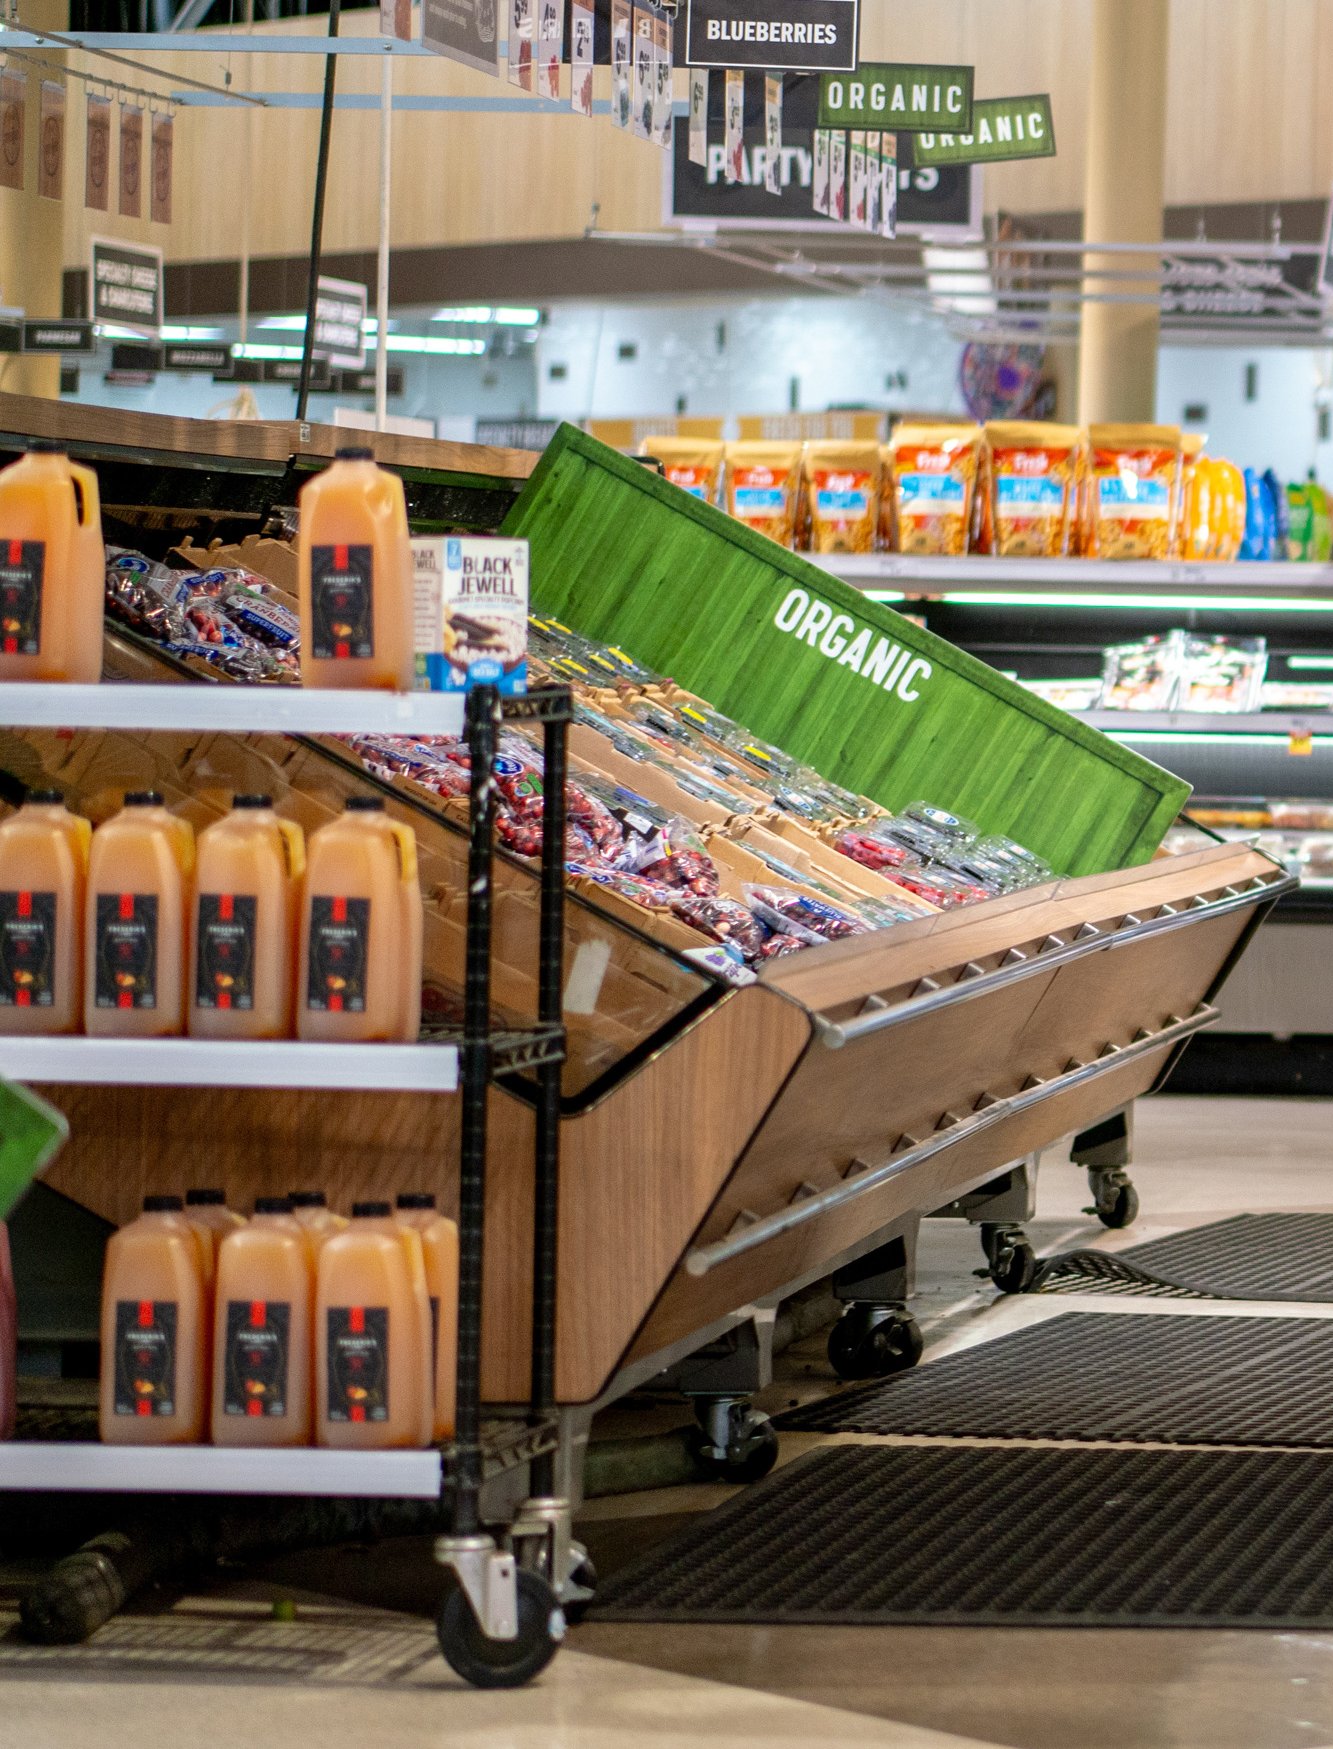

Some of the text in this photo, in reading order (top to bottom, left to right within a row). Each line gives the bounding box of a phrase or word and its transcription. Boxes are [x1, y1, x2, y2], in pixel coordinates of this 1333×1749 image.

[707, 19, 837, 46] BLUEBERRIES
[828, 81, 963, 113] ORGANIC
[463, 556, 513, 576] BLACK
[457, 576, 518, 597] JEWELL
[773, 588, 933, 703] ORGANIC
